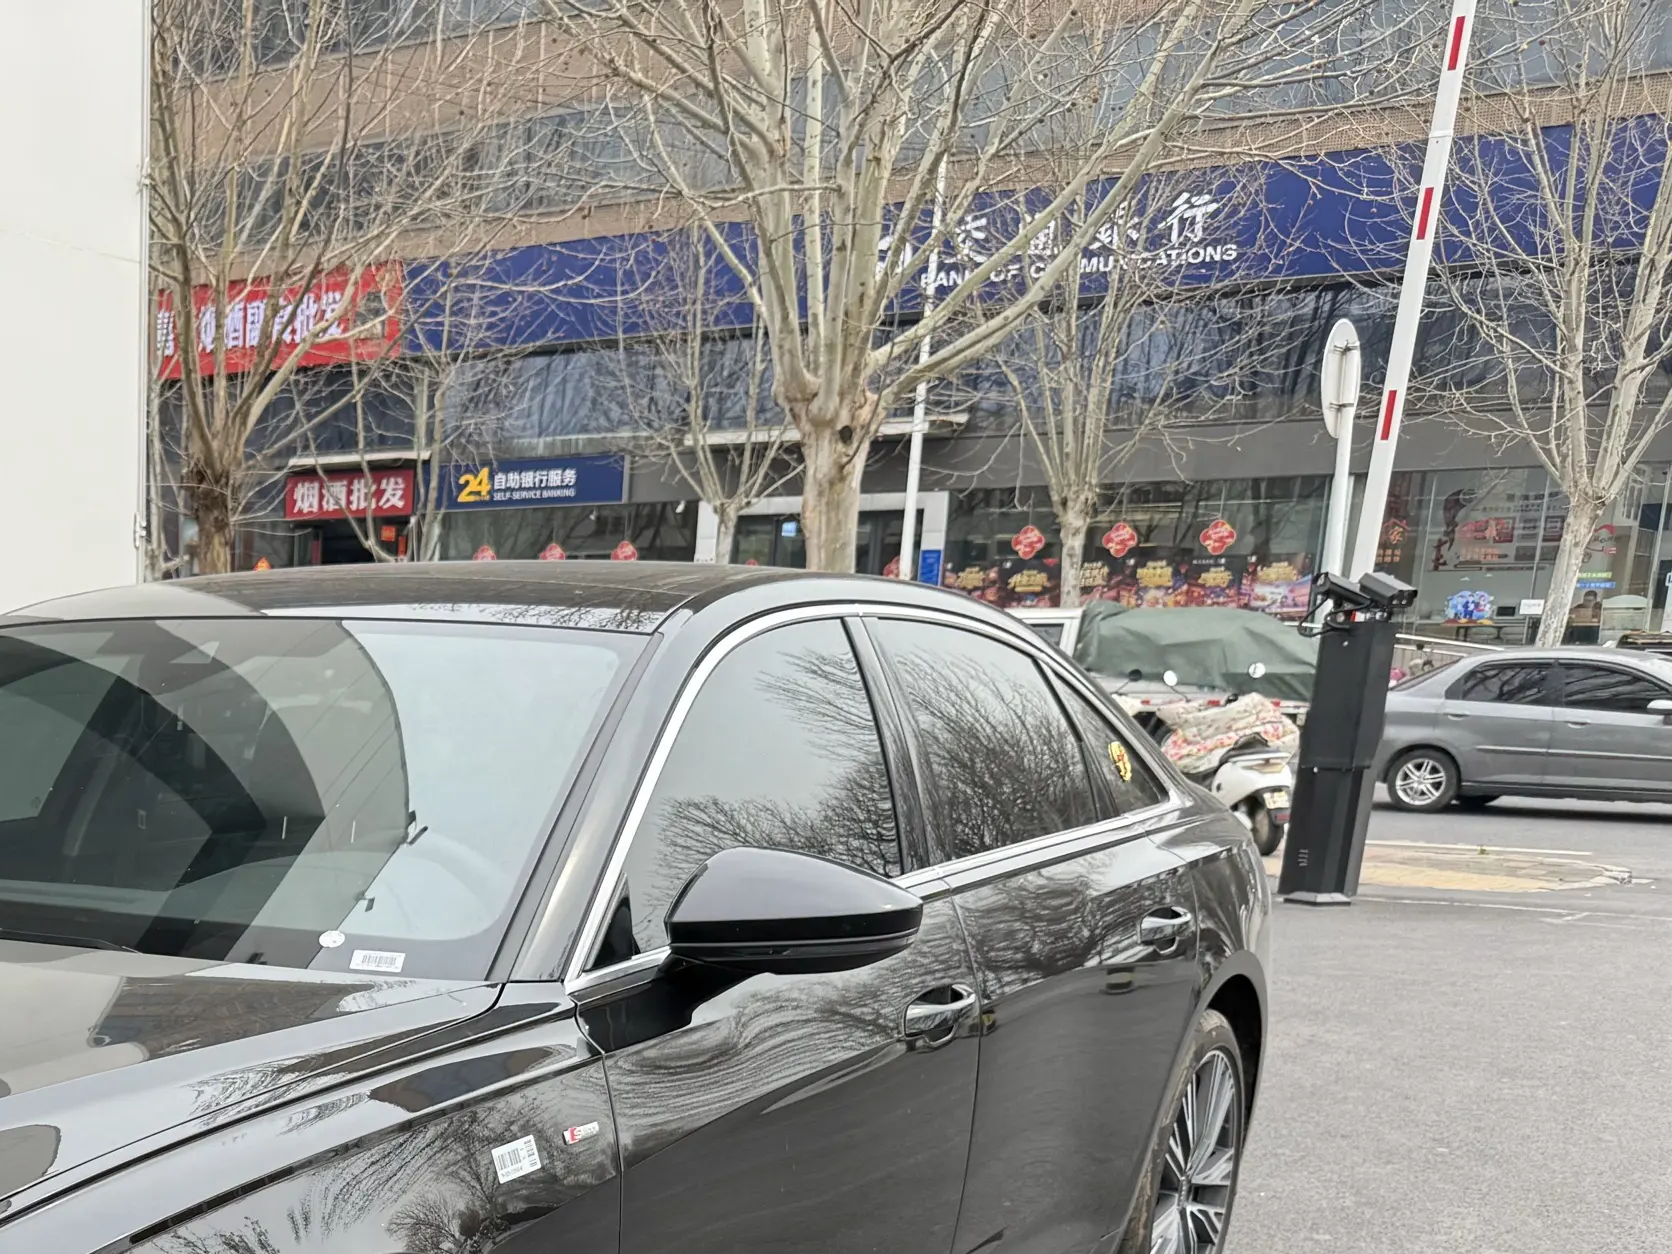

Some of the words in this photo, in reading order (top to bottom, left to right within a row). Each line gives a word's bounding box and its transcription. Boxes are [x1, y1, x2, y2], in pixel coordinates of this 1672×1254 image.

[457, 467, 491, 503] 24
[493, 468, 577, 490] 自助银行服务
[293, 476, 406, 513] 烟酒批发
[493, 489, 541, 501] SELF-SERVICE
